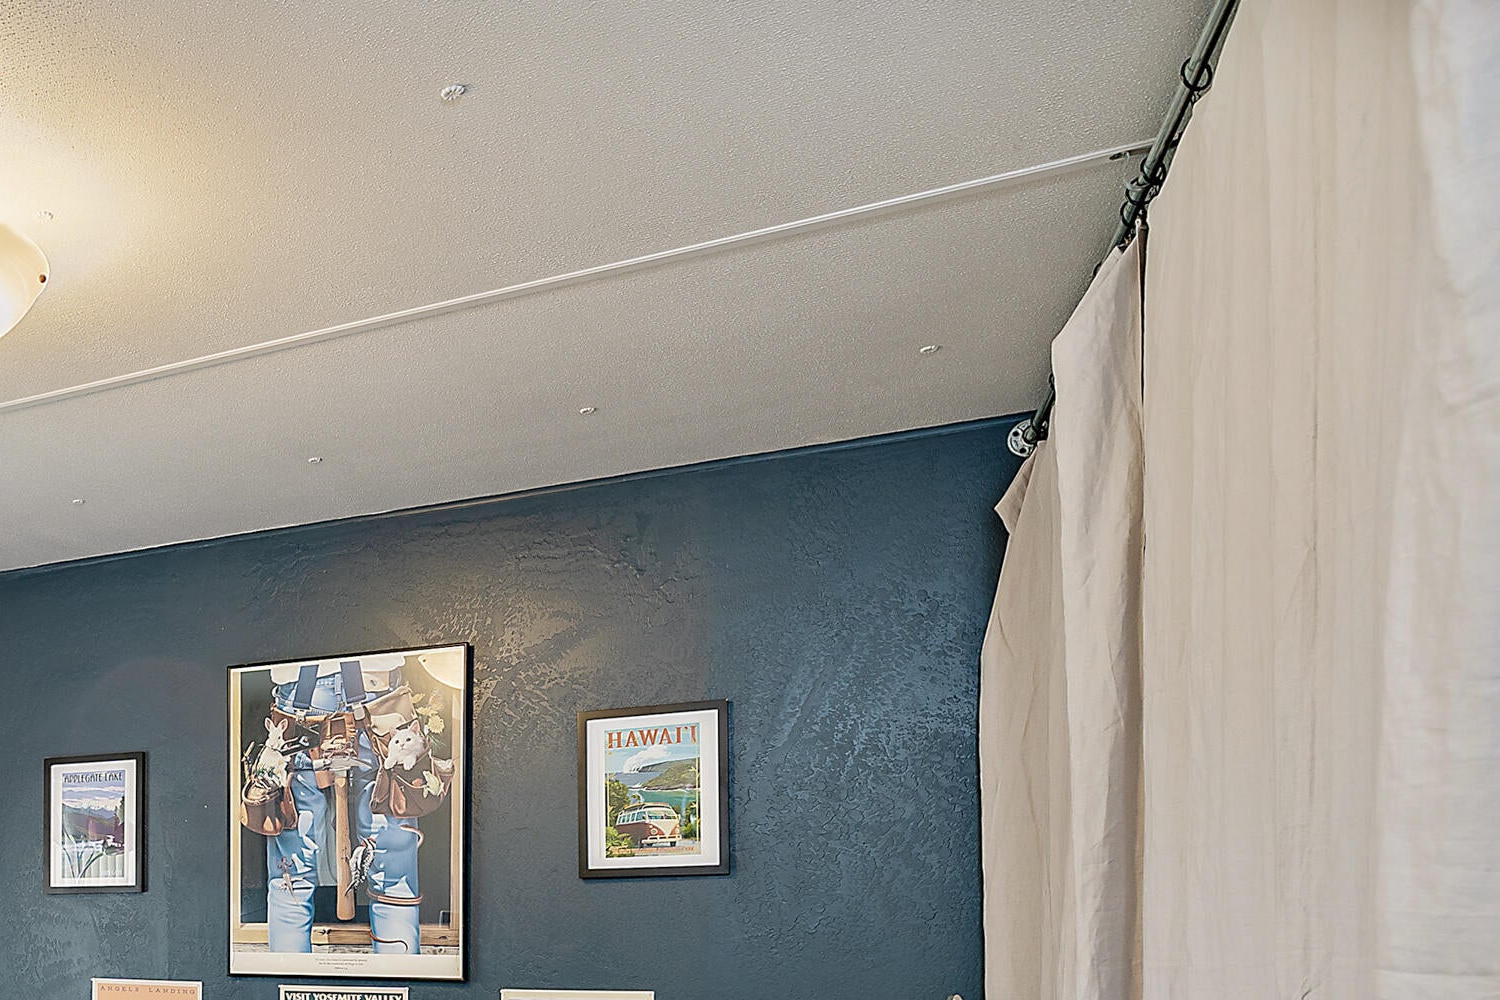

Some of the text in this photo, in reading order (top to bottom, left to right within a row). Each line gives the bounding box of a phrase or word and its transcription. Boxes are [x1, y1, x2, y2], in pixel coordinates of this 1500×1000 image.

[64, 772, 122, 783] APPLEGATE LAKE
[285, 992, 310, 1000] VISIT
